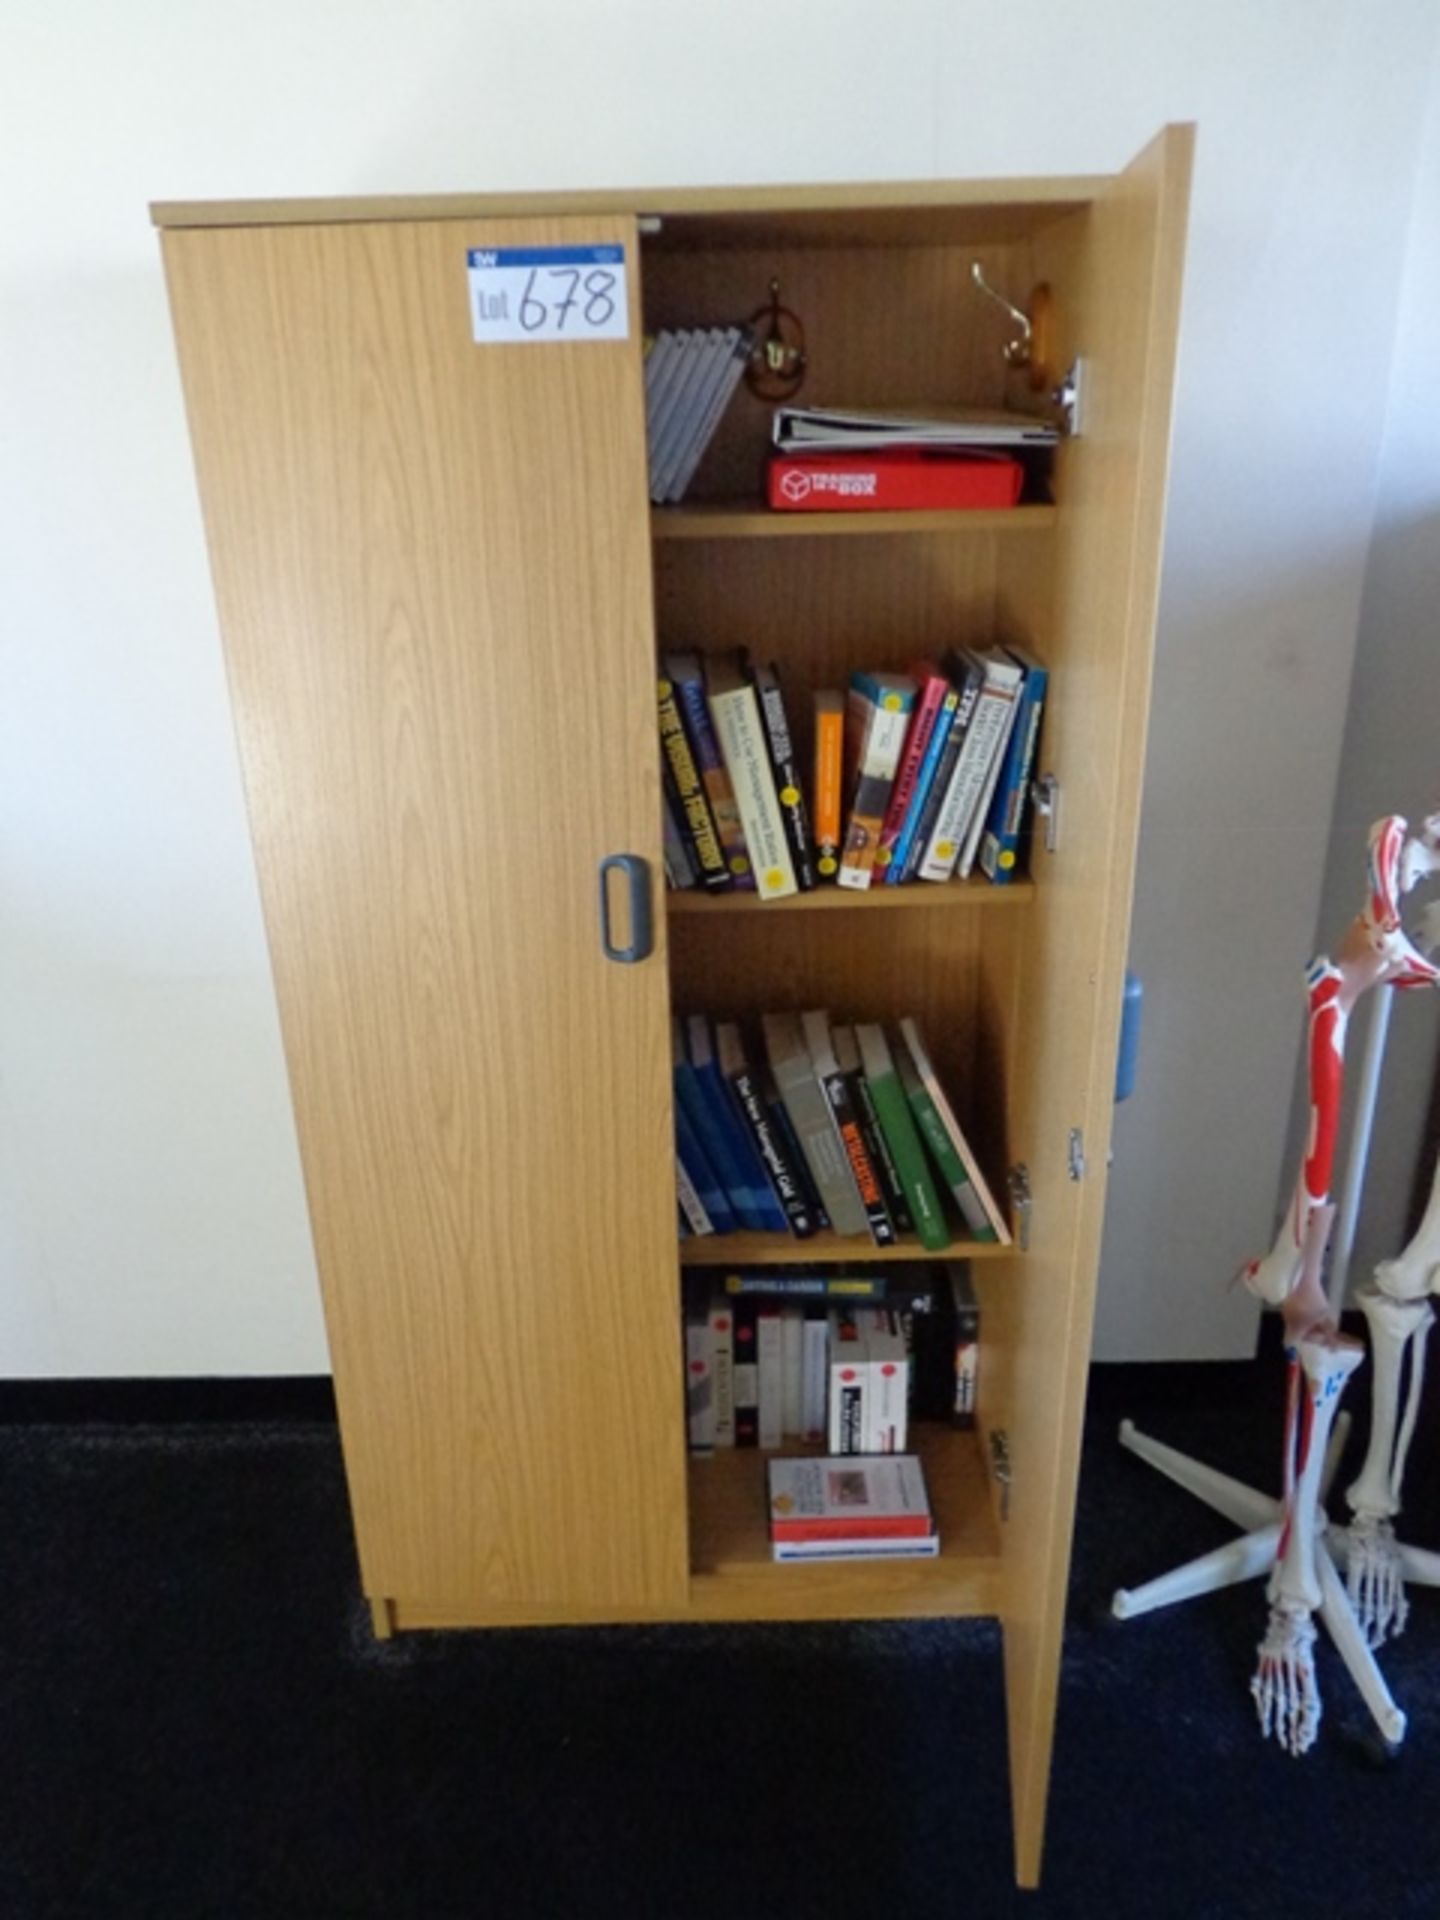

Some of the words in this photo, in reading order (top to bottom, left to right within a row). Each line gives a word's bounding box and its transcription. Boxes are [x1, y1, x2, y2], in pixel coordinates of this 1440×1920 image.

[478, 289, 510, 321] Lot
[518, 269, 617, 331] 678
[684, 796, 723, 871] FACTORY
[735, 1075, 753, 1097] The
[744, 1095, 763, 1121] New
[754, 1119, 785, 1177] Managerial
[775, 1173, 795, 1199] Grid
